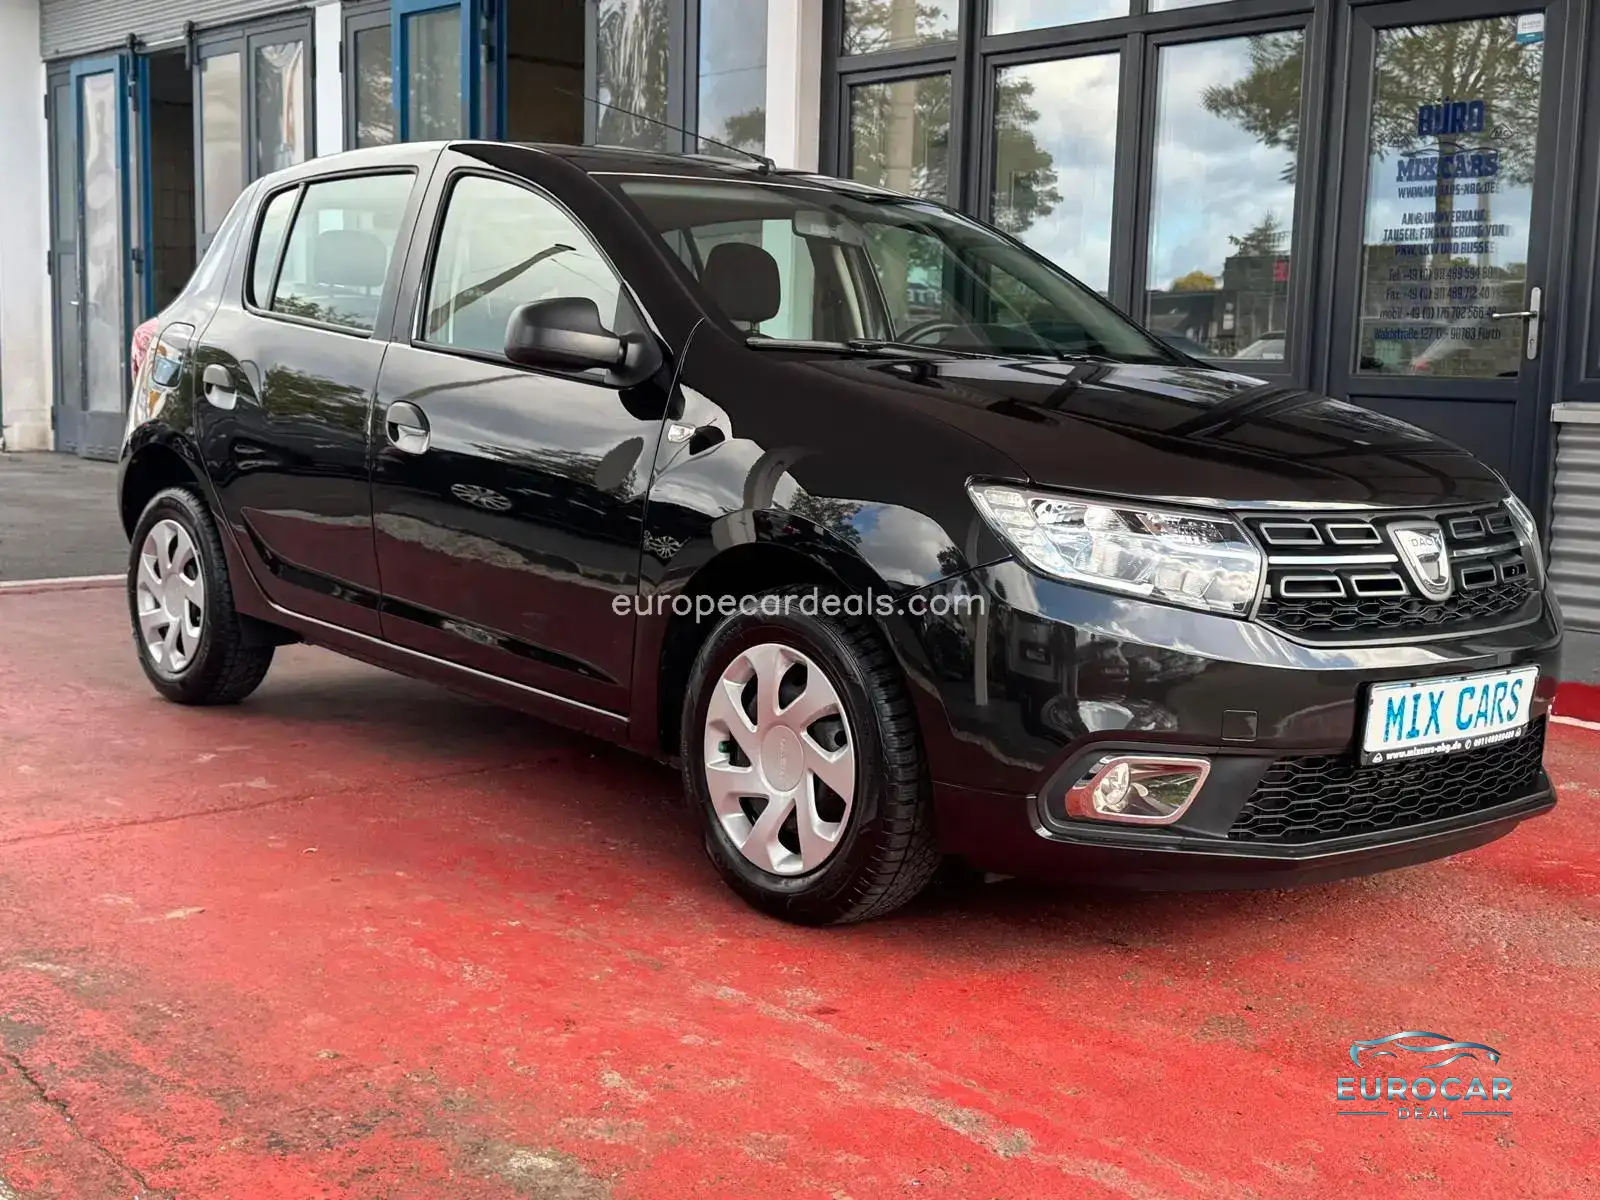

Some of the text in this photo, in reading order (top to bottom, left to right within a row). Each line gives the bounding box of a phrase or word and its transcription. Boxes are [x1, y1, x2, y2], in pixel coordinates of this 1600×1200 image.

[1417, 96, 1485, 136] BÜRO
[1396, 152, 1499, 182] MIX CARS
[1402, 212, 1414, 224] AN
[1445, 208, 1487, 222] VERKAUF
[1420, 224, 1485, 239] FINANZIERUNG
[1440, 241, 1459, 254] UND
[1383, 678, 1523, 743] MIX CARS
